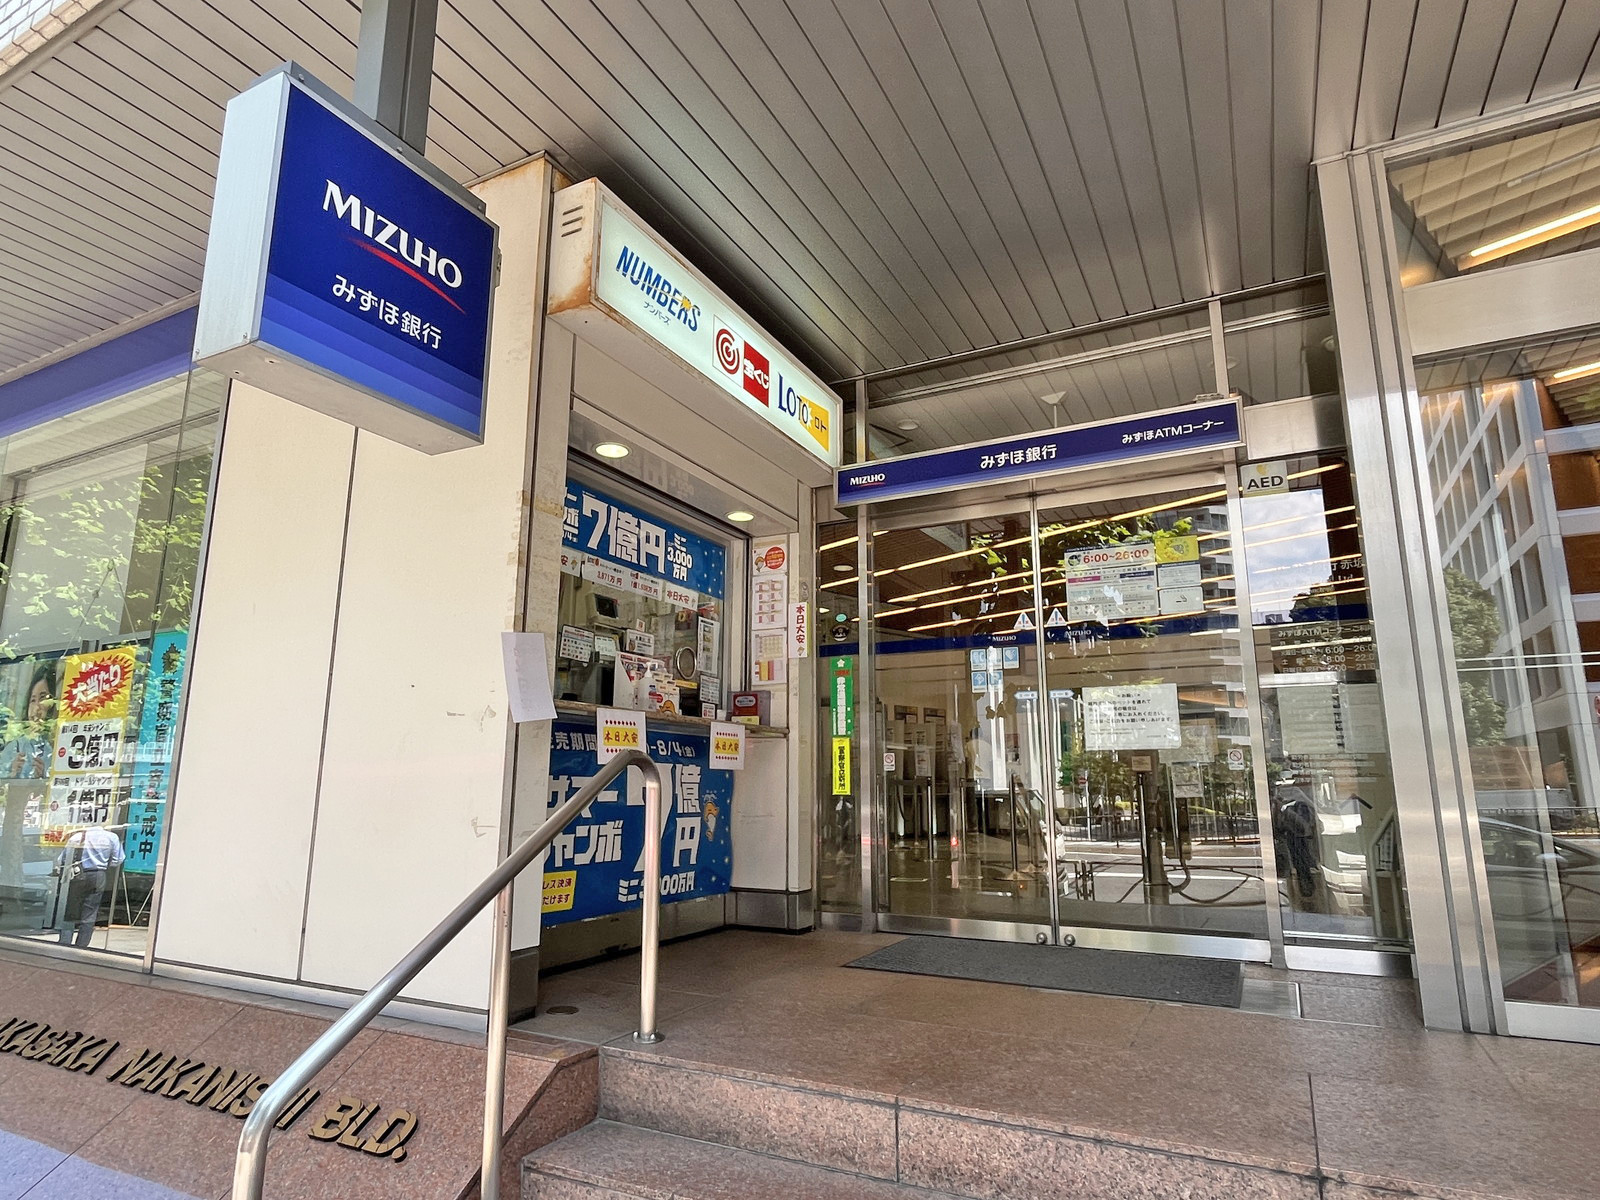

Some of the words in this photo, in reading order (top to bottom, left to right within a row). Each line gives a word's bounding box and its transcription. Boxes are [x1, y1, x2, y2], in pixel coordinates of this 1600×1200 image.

[322, 179, 463, 289] MIZUHO
[616, 245, 701, 332] NUMBERS
[332, 274, 442, 350] みずほ銀行
[643, 300, 671, 326] ナンバーズ
[743, 358, 770, 390] 宝くじ
[777, 372, 810, 425] LOTO
[814, 416, 827, 433] ロト
[1121, 419, 1225, 445] みずほATMコーナー
[980, 444, 1058, 470] みずほ銀行
[849, 473, 886, 486] MIZUHO
[1246, 475, 1285, 490] AED
[582, 492, 667, 574] 7億円
[674, 533, 687, 552] ミニ
[667, 589, 689, 604] 本日大安
[796, 604, 806, 644] 本日大安
[72, 664, 121, 707] 大当たり
[551, 731, 598, 751] 売期間
[604, 729, 639, 744] 本日大安
[714, 738, 740, 752] 本日大安
[0, 1018, 120, 1075] KASAKA
